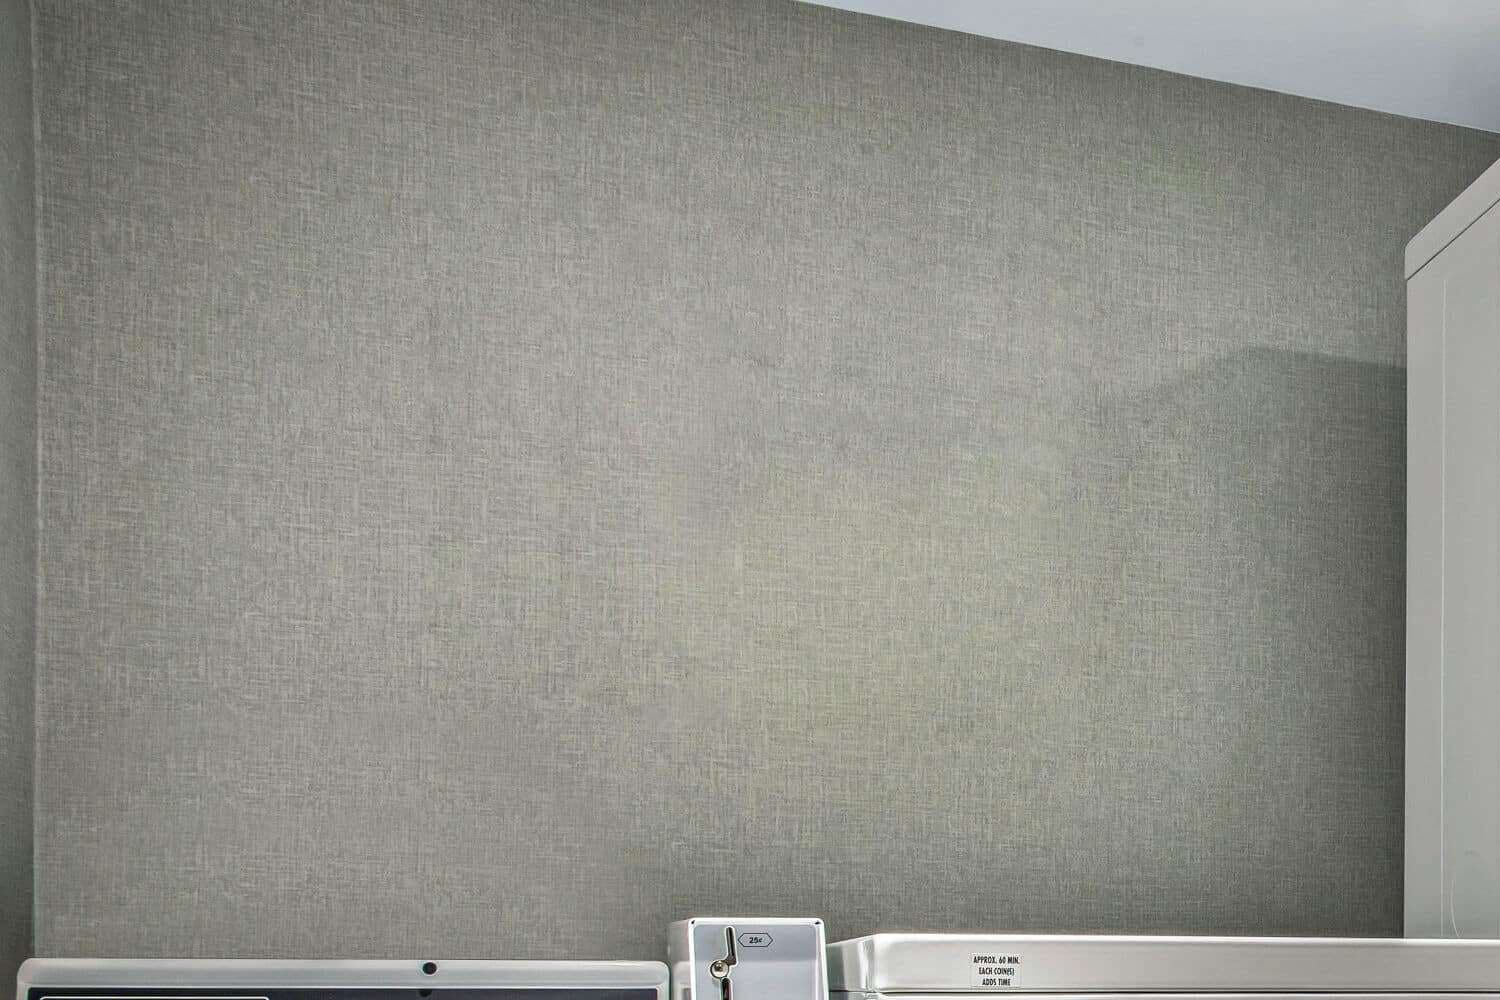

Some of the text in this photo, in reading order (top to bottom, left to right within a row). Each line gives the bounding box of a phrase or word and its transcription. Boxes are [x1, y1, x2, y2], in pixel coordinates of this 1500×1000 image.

[974, 956, 1020, 964] APPROX. 60 MIN.
[994, 967, 1014, 976] COIN(S)
[982, 978, 1011, 986] ADDS TIME
